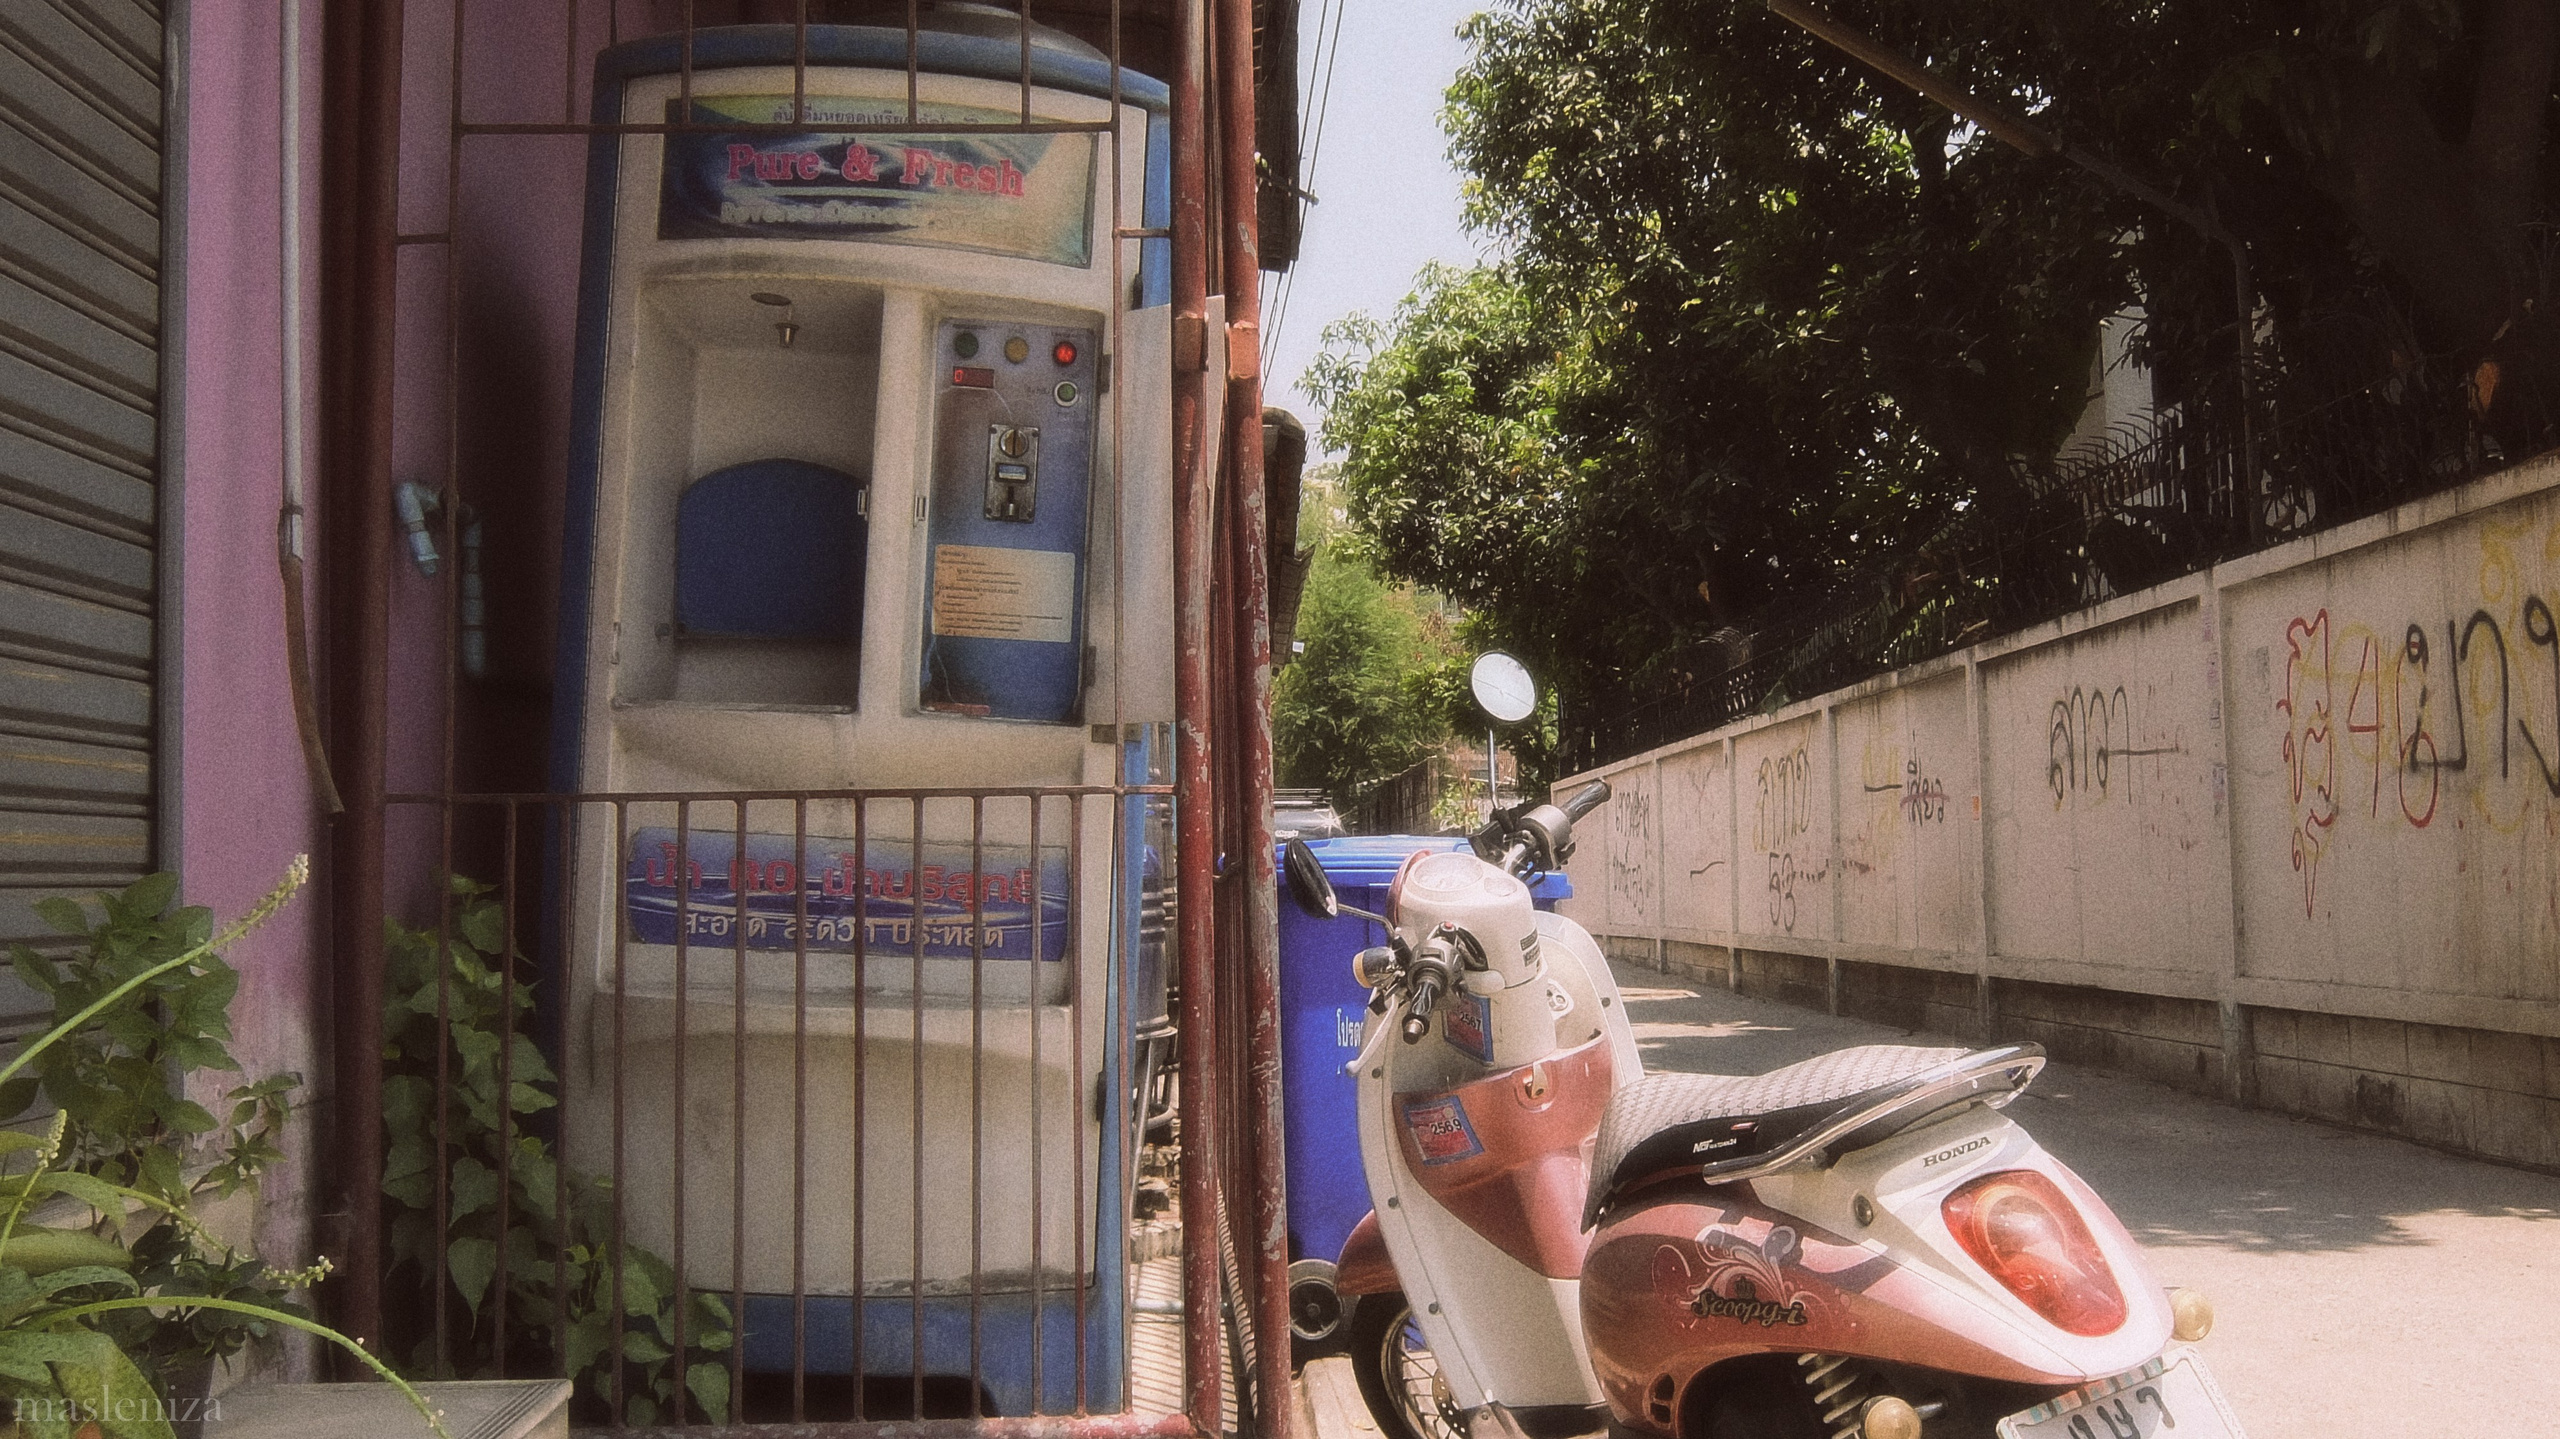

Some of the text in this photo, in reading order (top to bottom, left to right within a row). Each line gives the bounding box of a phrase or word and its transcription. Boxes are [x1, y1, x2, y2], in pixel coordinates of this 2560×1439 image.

[727, 143, 1025, 197] Pure & Fresh
[646, 840, 702, 889] น้ำ
[684, 913, 767, 939] สะอด
[892, 921, 1004, 948] ประหยด
[1431, 1118, 1463, 1135] 2569
[1922, 1136, 1992, 1168] HONDA
[1690, 1287, 1809, 1328] Scoopy-i
